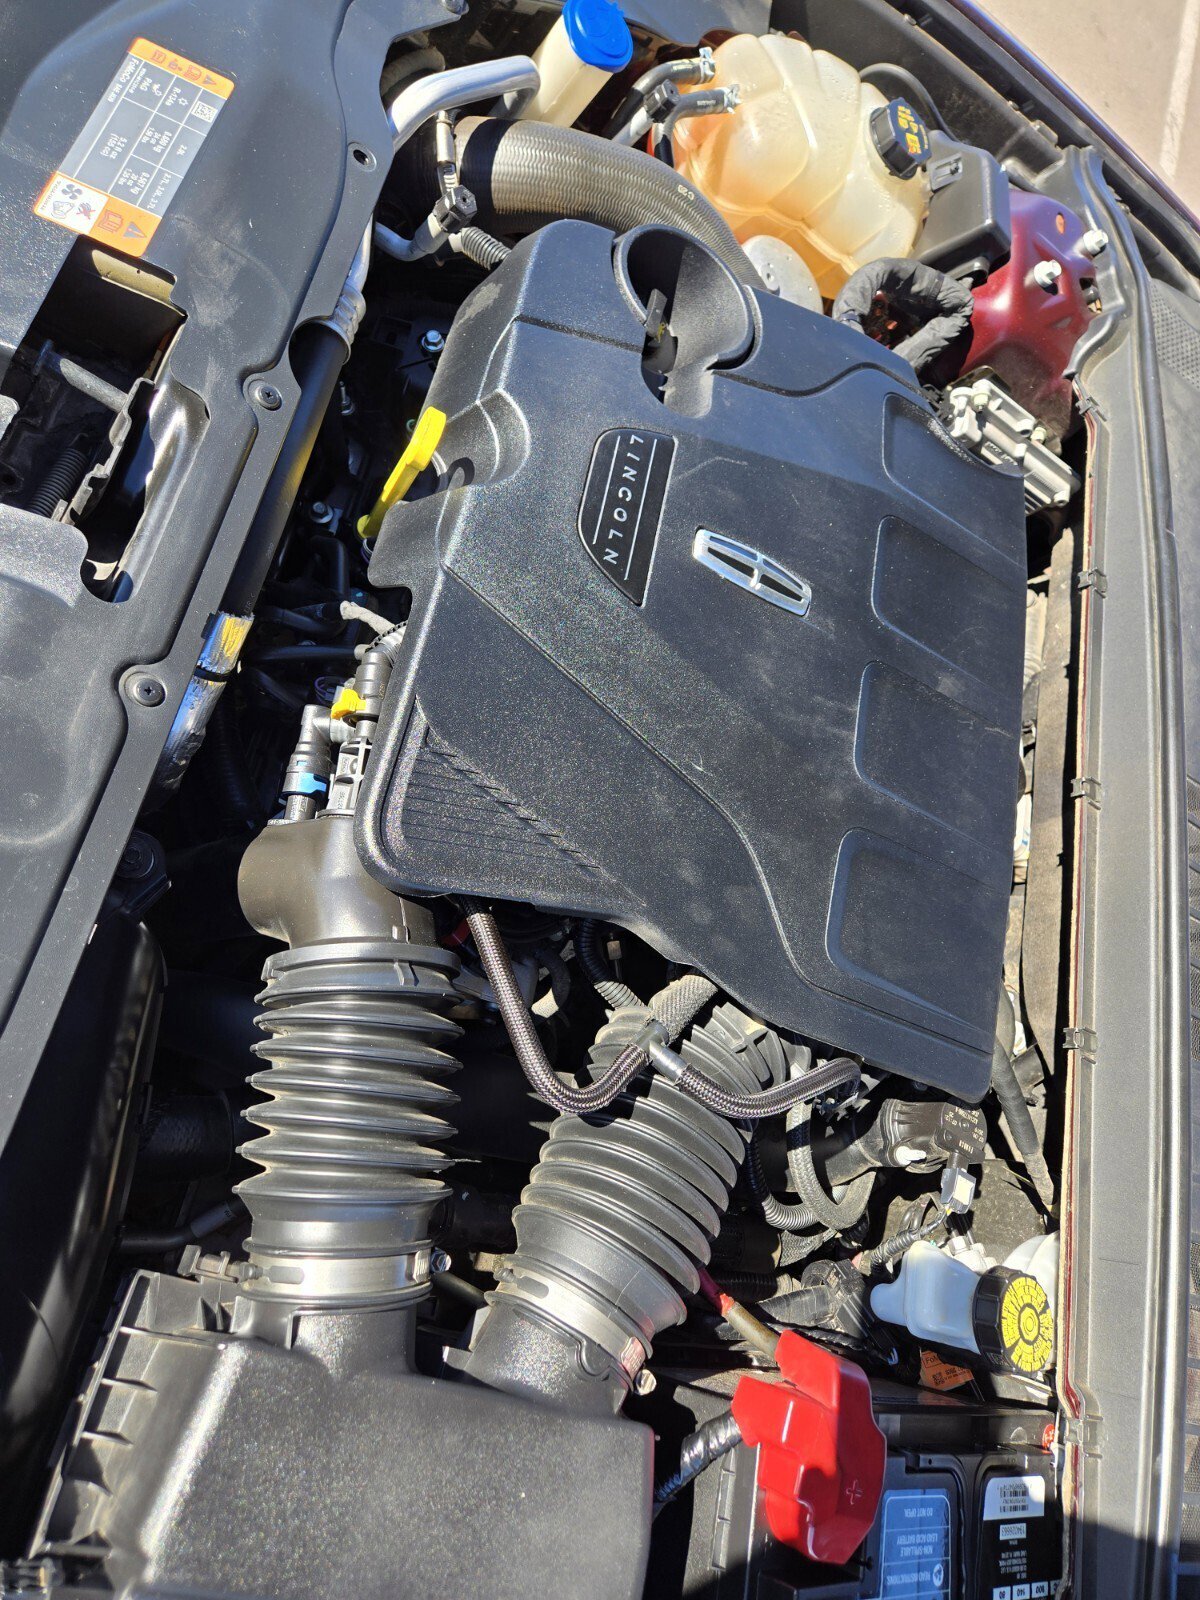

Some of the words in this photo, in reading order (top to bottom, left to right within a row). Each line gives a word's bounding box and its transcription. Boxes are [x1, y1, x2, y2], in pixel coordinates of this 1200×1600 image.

[120, 58, 139, 83] FoMoCo
[140, 77, 152, 92] PAG
[165, 86, 181, 107] R-134a
[602, 434, 644, 565] LINCOLN
